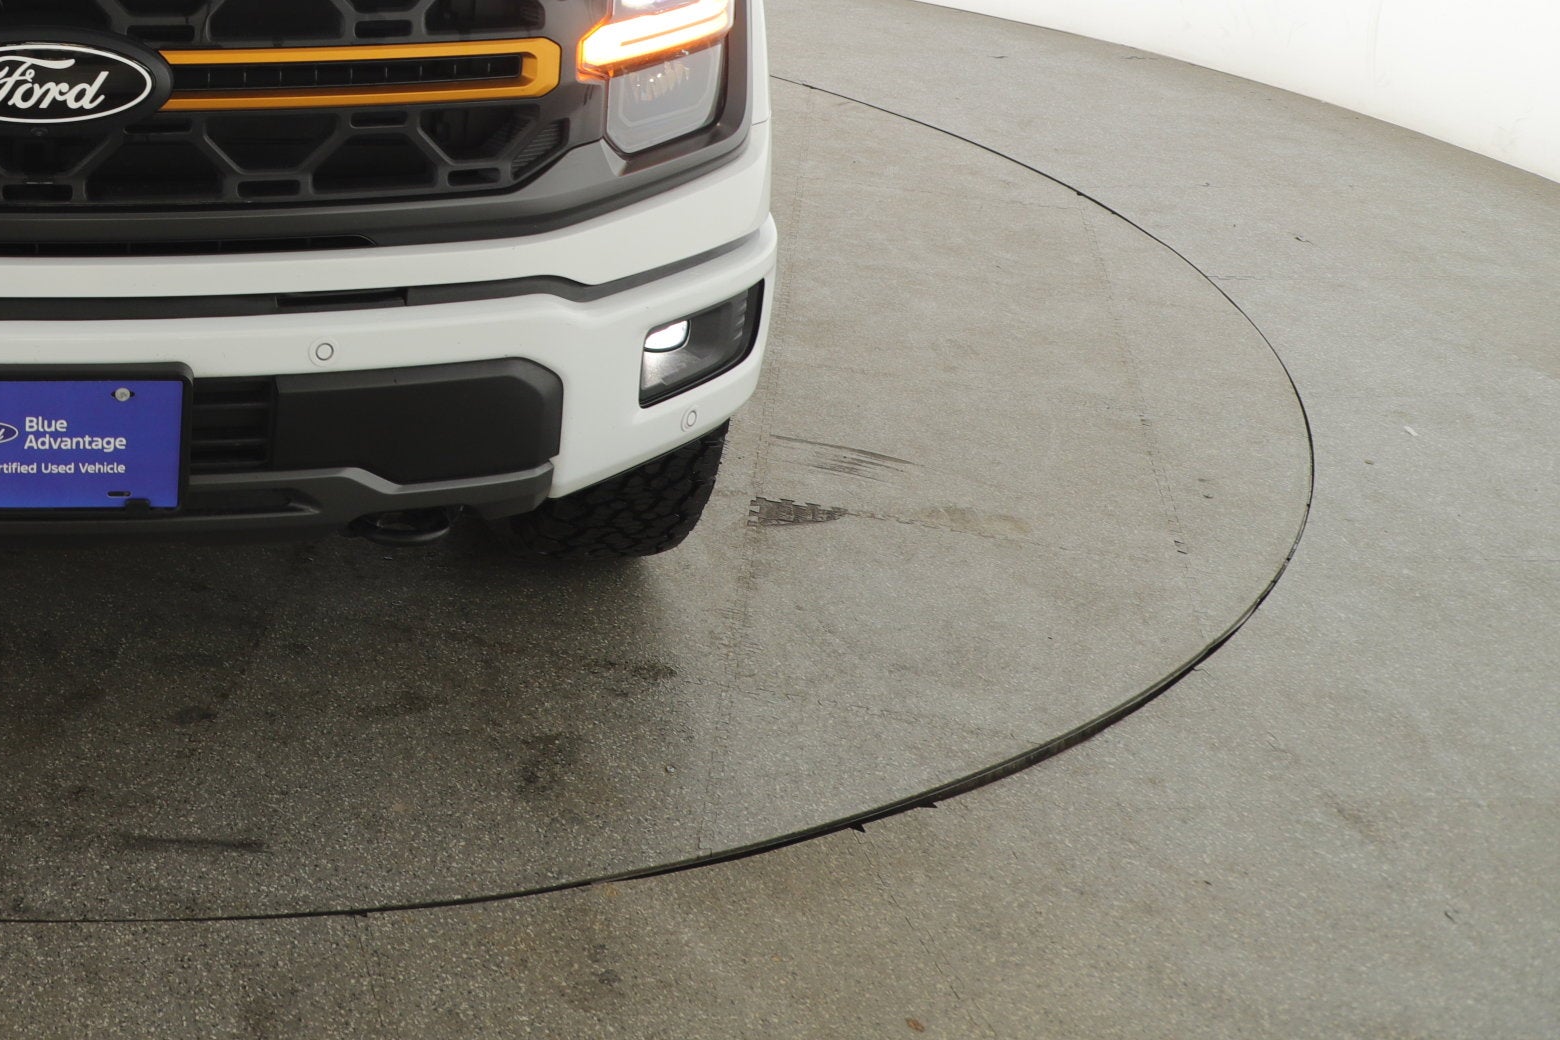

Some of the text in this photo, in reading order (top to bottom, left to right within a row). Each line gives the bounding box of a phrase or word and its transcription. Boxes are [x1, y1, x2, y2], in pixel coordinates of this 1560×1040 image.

[25, 416, 68, 432] Blue
[24, 434, 127, 452] Advantage
[41, 462, 75, 474] Used
[79, 462, 126, 474] Vehicle
